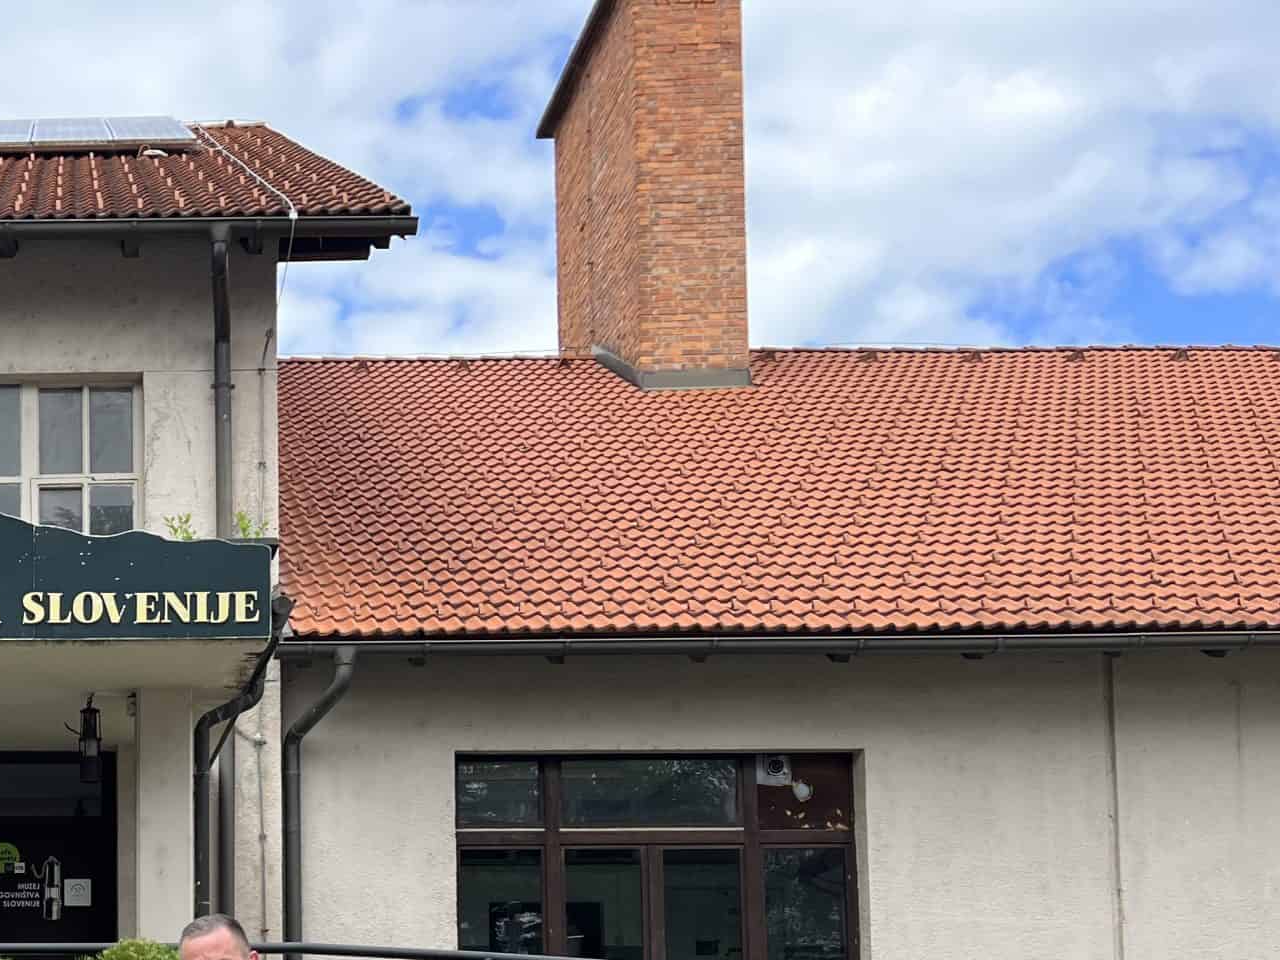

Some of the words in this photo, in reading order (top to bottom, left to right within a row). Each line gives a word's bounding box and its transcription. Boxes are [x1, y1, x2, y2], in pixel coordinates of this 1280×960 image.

[22, 590, 261, 625] SLOVENIJE
[17, 883, 40, 891] MUZEJ
[3, 900, 40, 908] SLOVENIJE
